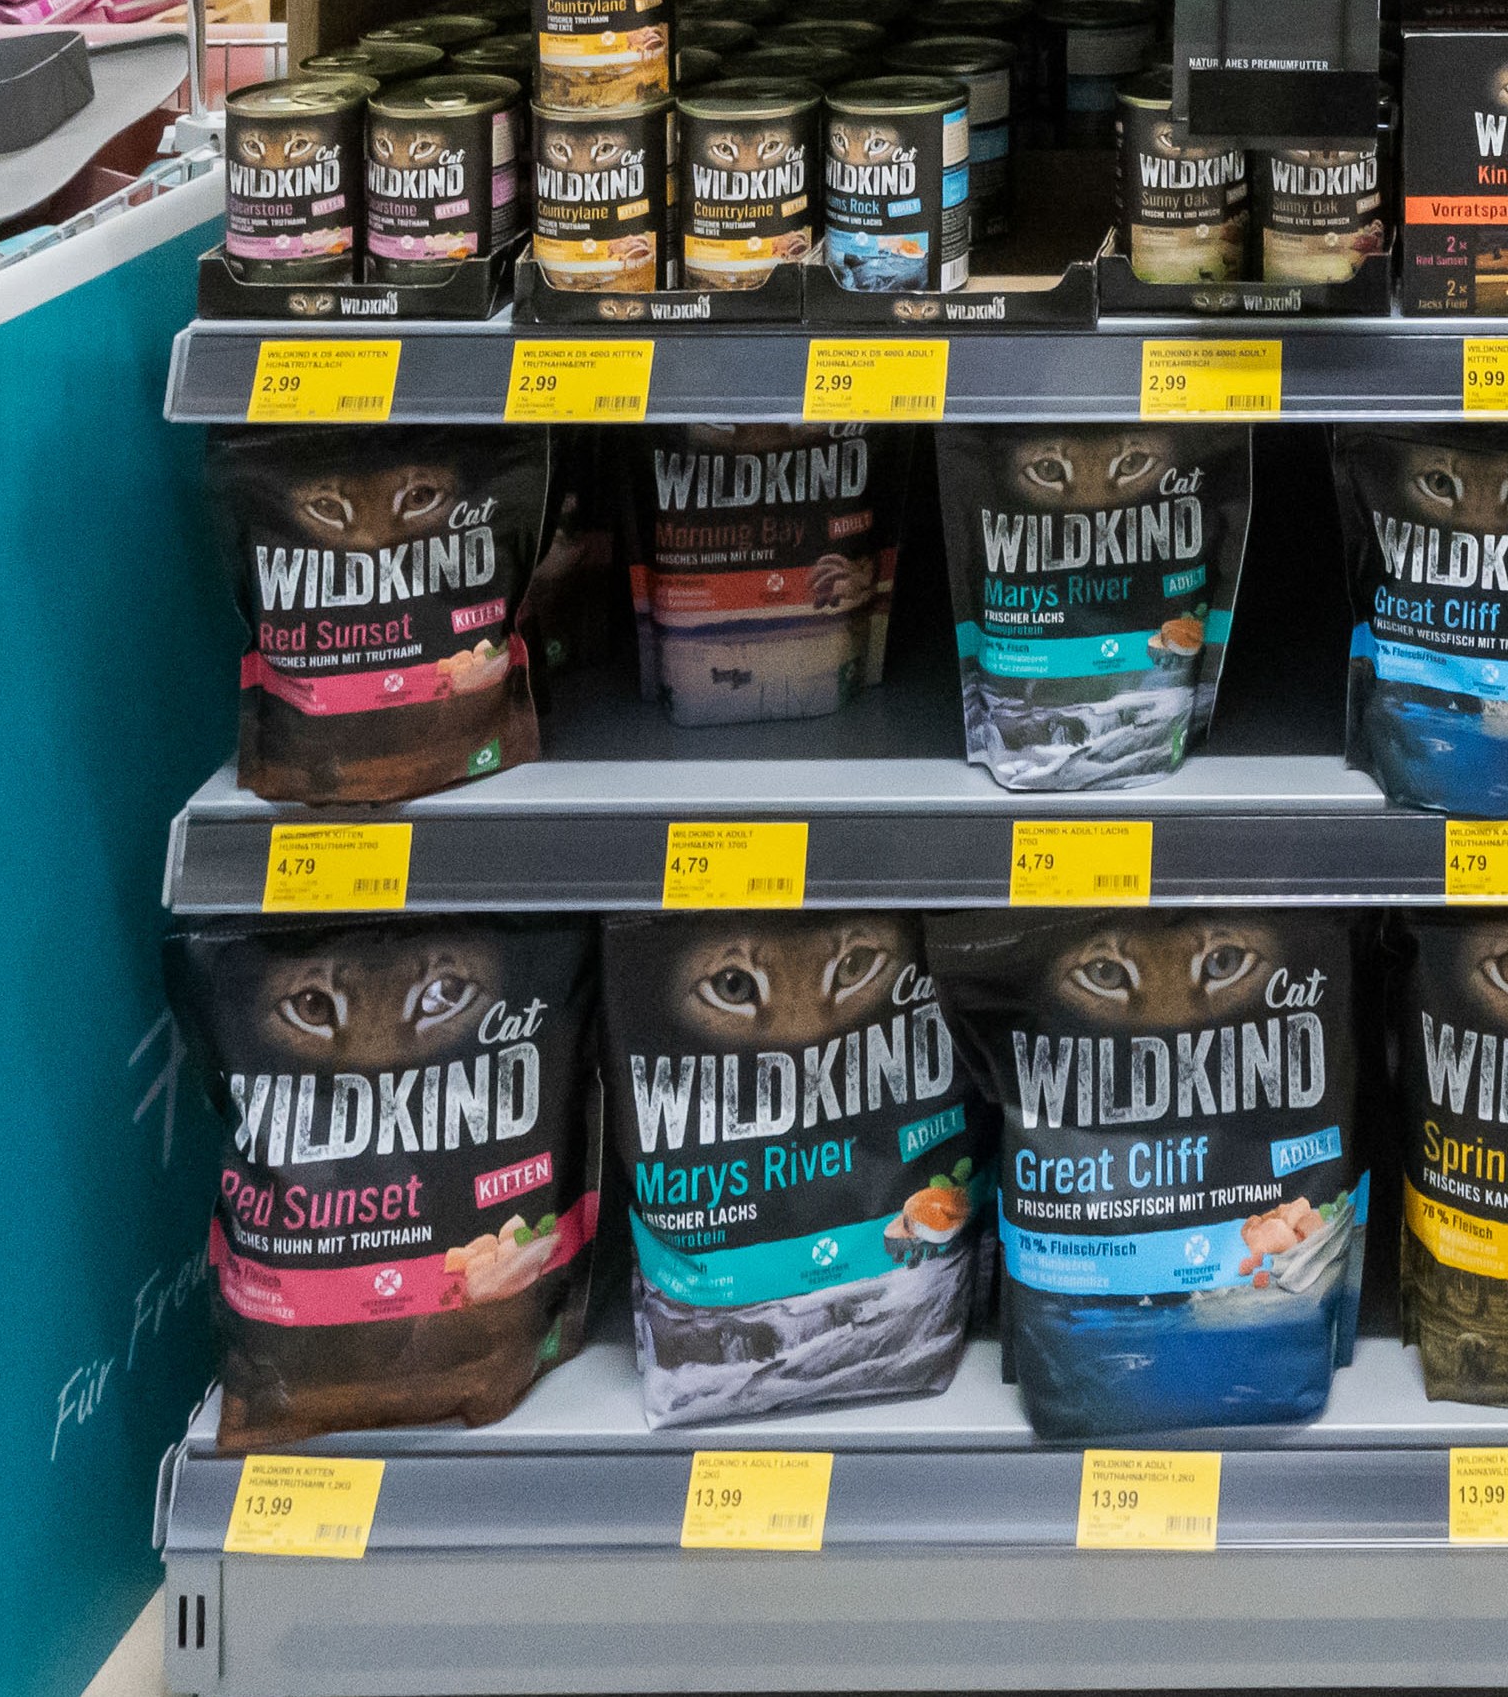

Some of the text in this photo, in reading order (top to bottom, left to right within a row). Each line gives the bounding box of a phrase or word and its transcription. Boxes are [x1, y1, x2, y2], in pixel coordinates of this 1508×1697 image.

[695, 202, 774, 221] Countrylane
[519, 375, 557, 394] 2,99
[1468, 371, 1505, 387] 9,99
[449, 500, 497, 530] Cat
[982, 496, 1202, 574] WILDKIND
[256, 526, 494, 612] WILDKIND
[985, 575, 1132, 609] Marys River
[1374, 585, 1501, 631] Great Cliff
[259, 613, 413, 653] Red Sunset
[455, 603, 503, 629] KITTEN
[1032, 611, 1064, 624] LACHS
[365, 643, 422, 662] TRUTHAHN
[1449, 854, 1487, 872] 4,79
[1265, 968, 1326, 1011] Cat
[478, 999, 548, 1045] Cat
[630, 1002, 954, 1153] WILDKIND
[1013, 1011, 1326, 1130] WILDKIND
[224, 1041, 540, 1167] WILDKIND
[478, 1159, 550, 1200] KITTEN
[636, 1135, 856, 1212] Marys River
[1014, 1135, 1209, 1194] Great Cliff
[282, 1178, 422, 1229] Sunset
[709, 1204, 758, 1225] LACHS
[1016, 1183, 1283, 1220] FRISCHER WEISSFISCH MIT TRUTHAHN
[51, 1356, 114, 1461] Für
[1457, 1484, 1505, 1507] 13,99
